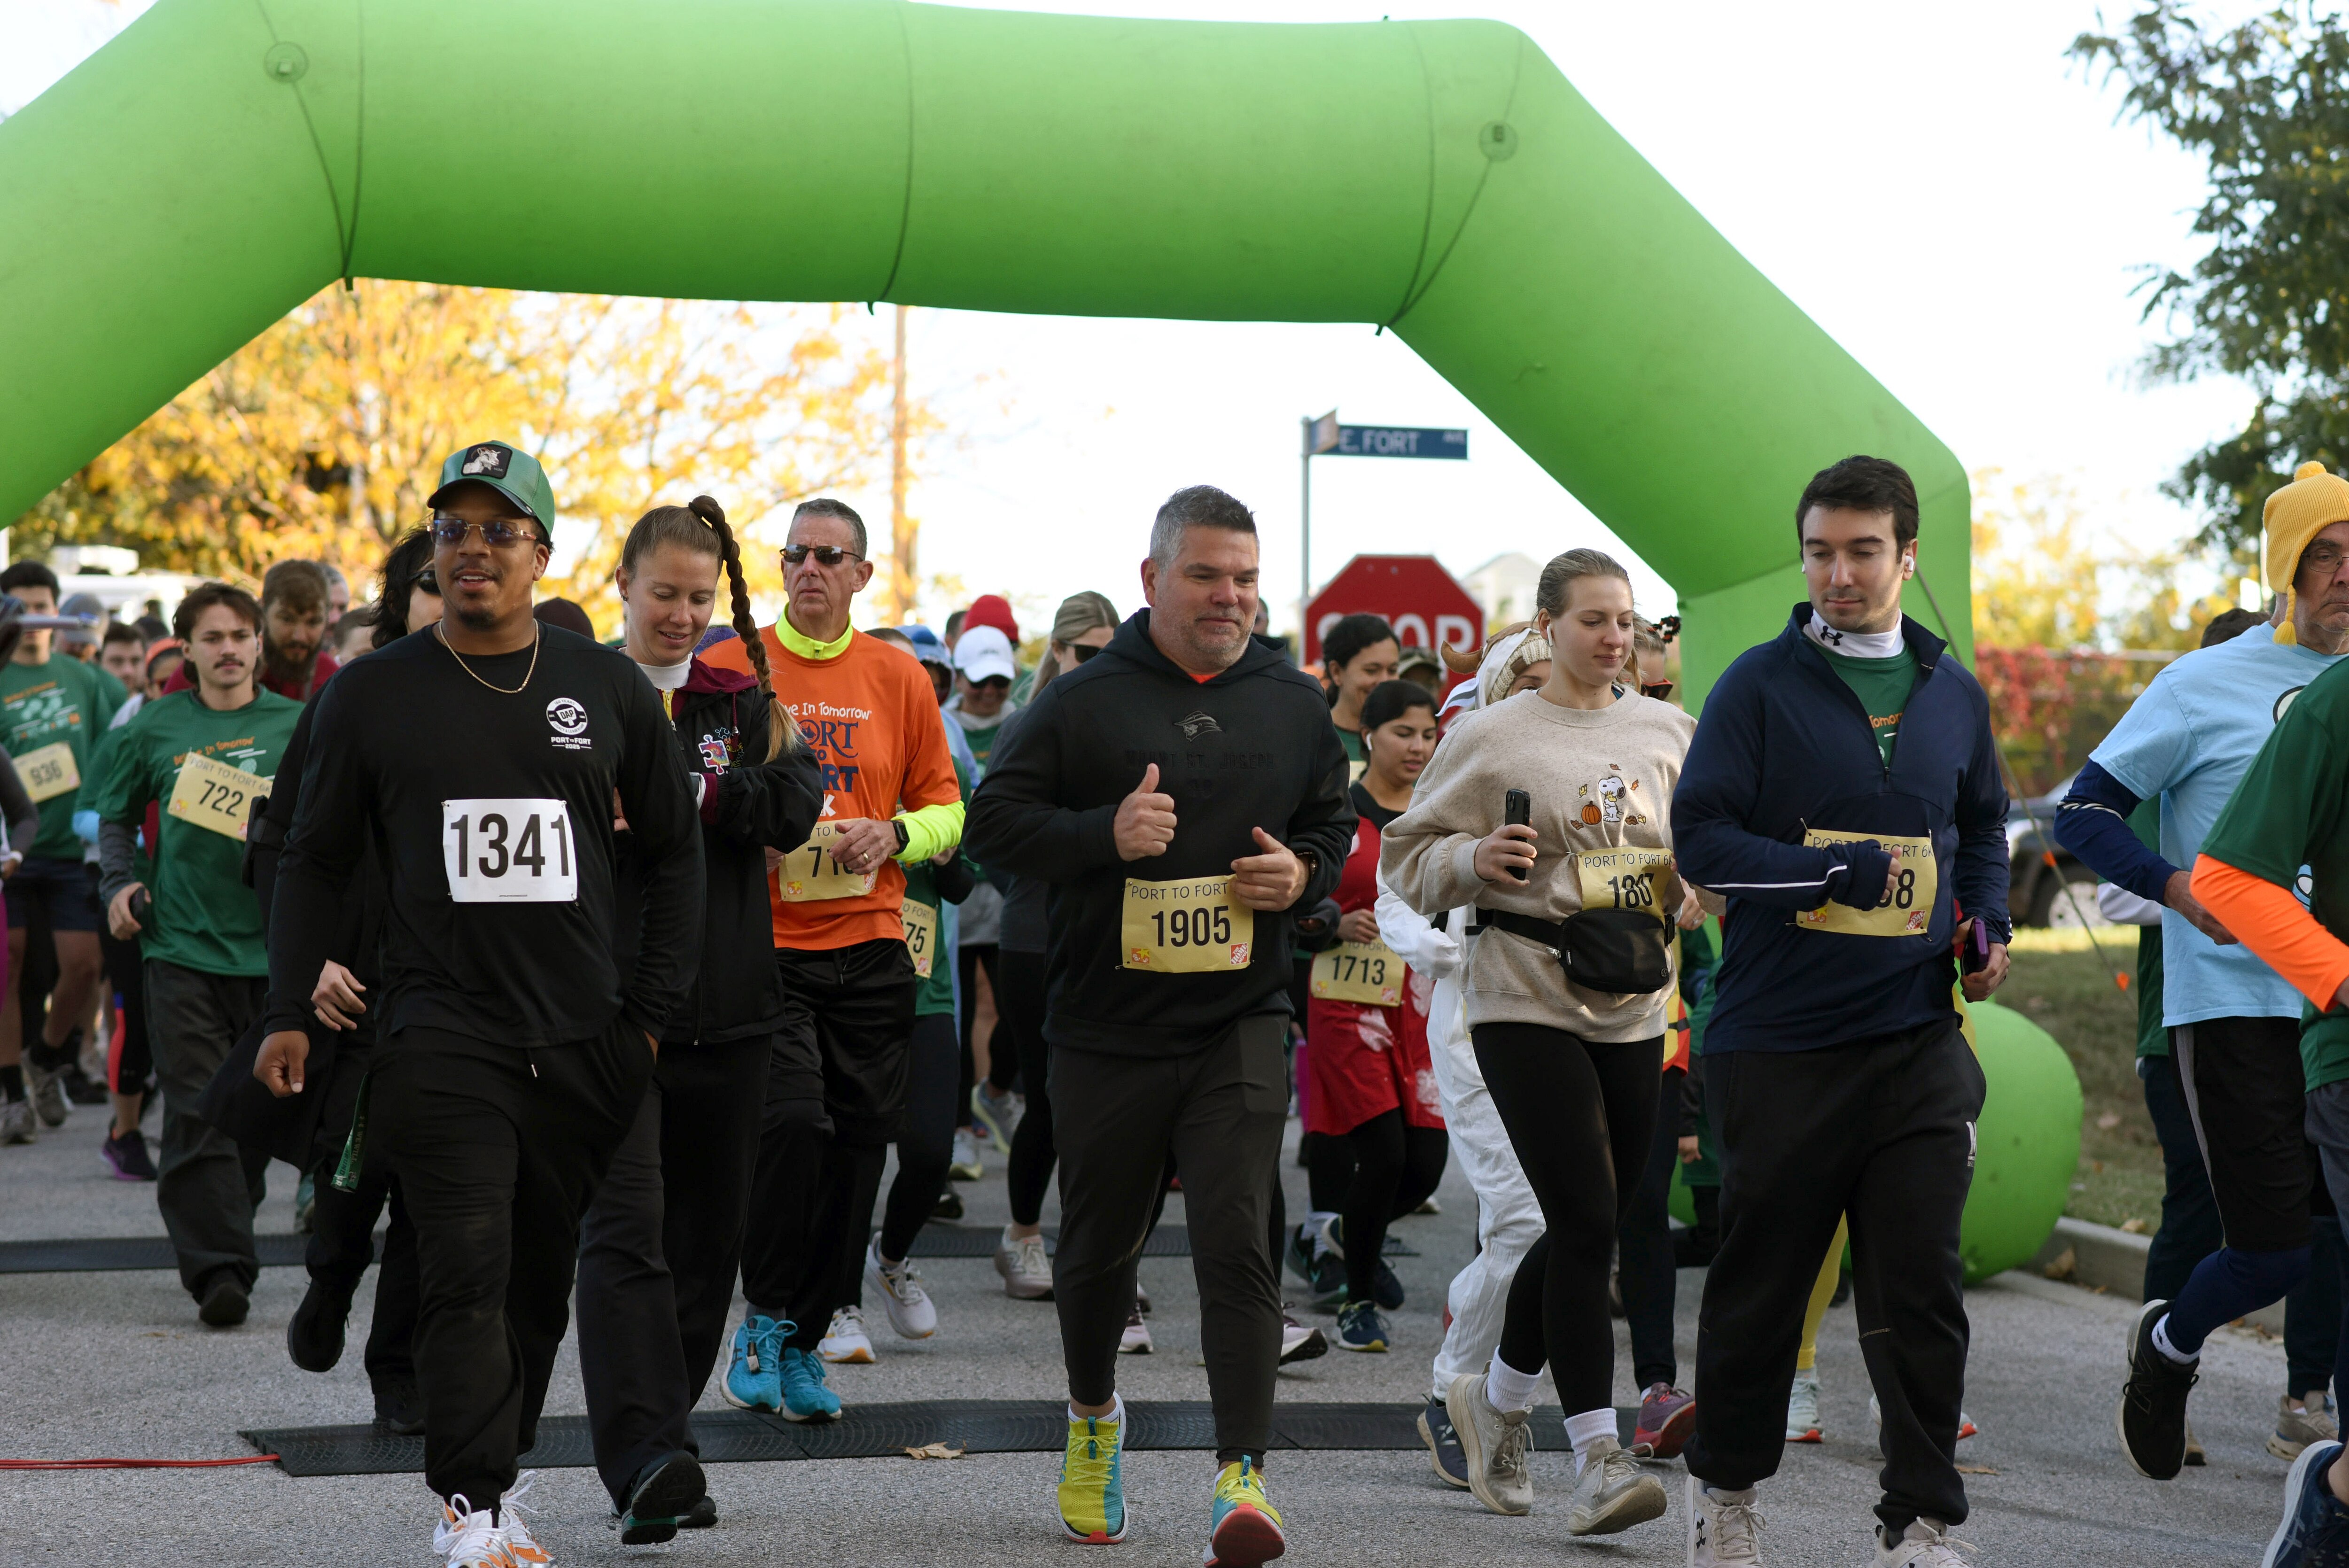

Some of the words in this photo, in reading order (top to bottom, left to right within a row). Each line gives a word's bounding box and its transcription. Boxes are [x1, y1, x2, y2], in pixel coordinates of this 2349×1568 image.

[1362, 430, 1421, 454] FORT
[1316, 613, 1475, 682] OP
[560, 709, 574, 720] DAP
[802, 702, 816, 715] In
[818, 702, 870, 720] Tomorrow
[794, 719, 858, 758] ORT
[191, 757, 214, 771] PORT
[218, 766, 231, 778] TO
[232, 773, 257, 787] FORT
[1220, 752, 1274, 769] JOSEPH
[820, 764, 859, 793] RT
[198, 779, 244, 817] 722
[816, 826, 831, 837] TO
[450, 813, 569, 878] 1341
[1921, 845, 1934, 858] 6K
[1584, 854, 1617, 869] PORT
[1621, 853, 1635, 865] TO
[1638, 853, 1661, 866] FORT
[1131, 885, 1167, 900] PORT
[1171, 885, 1190, 899] TO
[1195, 882, 1228, 897] FORT
[901, 919, 927, 954] 75
[1151, 905, 1231, 947] 1905
[1230, 943, 1247, 964] HOME
[1332, 955, 1386, 986] 1713
